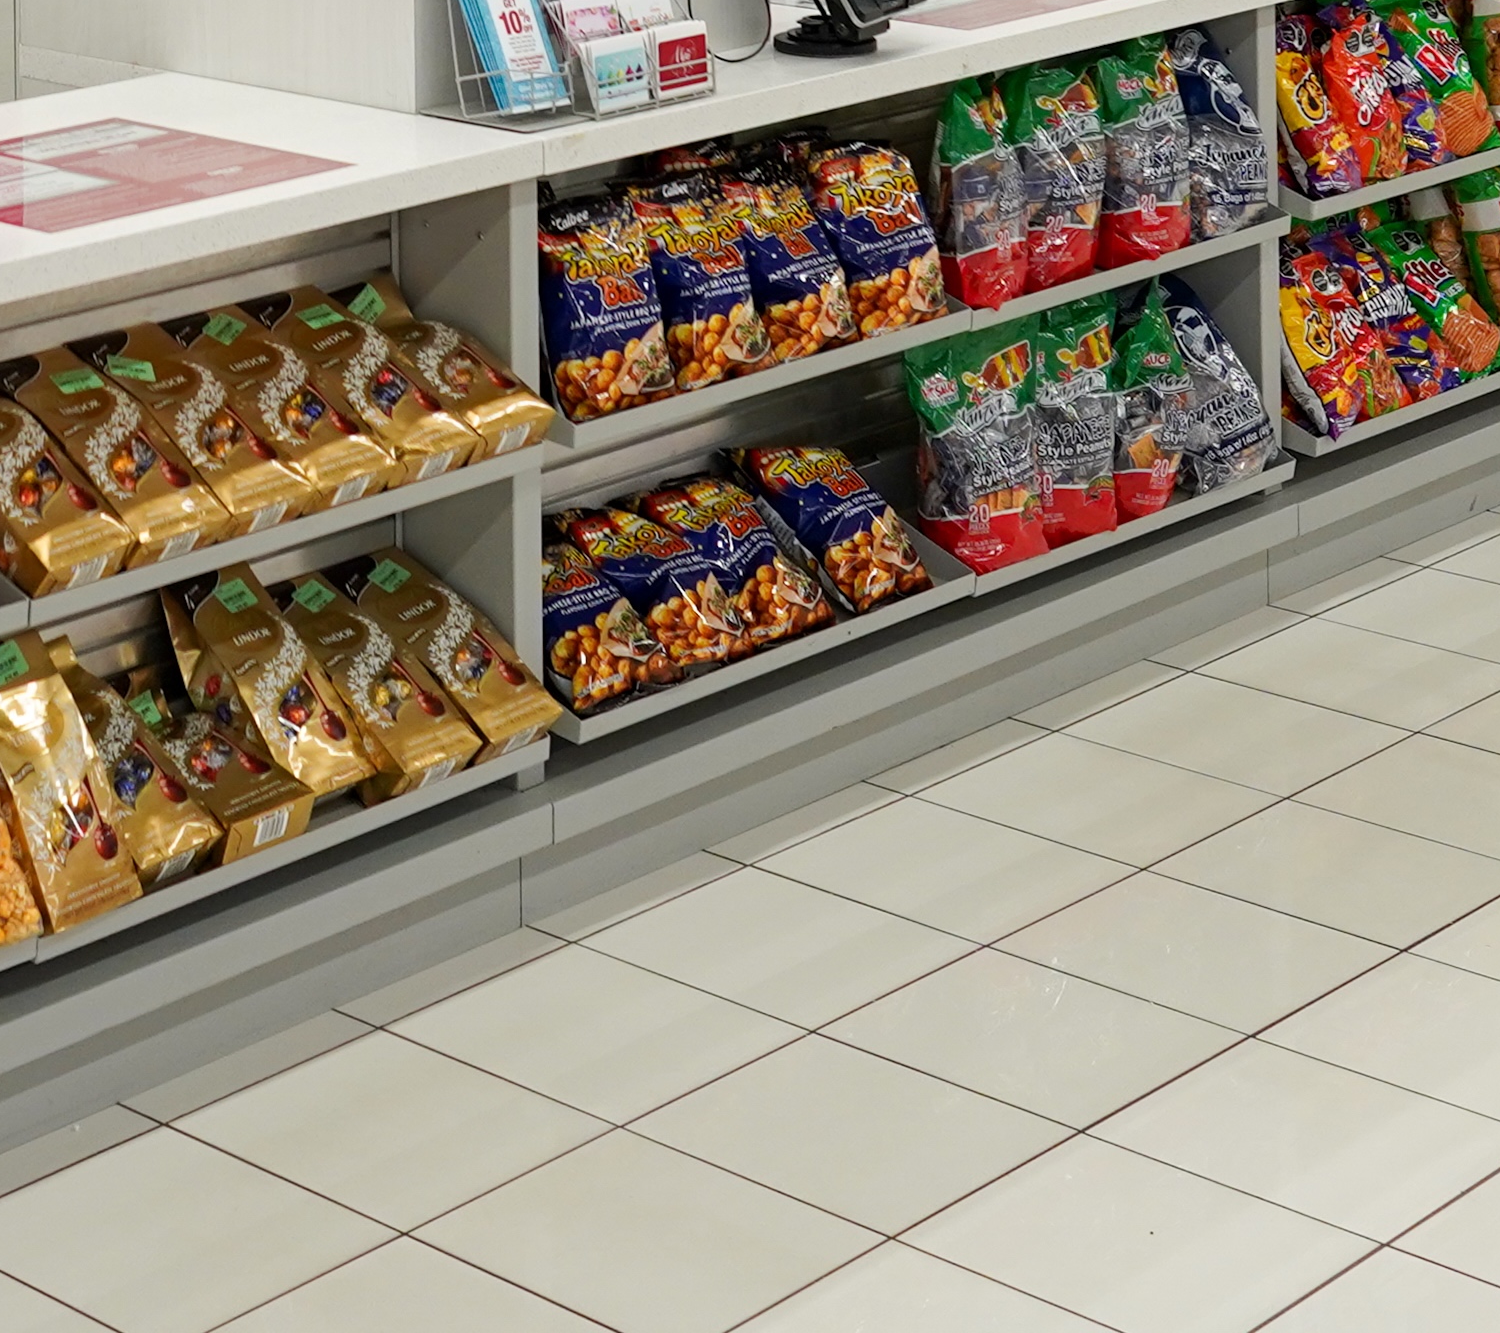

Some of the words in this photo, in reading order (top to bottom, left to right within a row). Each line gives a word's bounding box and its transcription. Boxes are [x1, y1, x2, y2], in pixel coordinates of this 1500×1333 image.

[499, 8, 530, 35] 10%
[1140, 194, 1157, 211] 20
[556, 208, 590, 231] Calbee
[865, 199, 923, 235] Ball
[1045, 216, 1065, 233] 20
[691, 243, 745, 275] Ball
[1037, 444, 1074, 457] Style
[1076, 437, 1113, 455] Peanuts
[1162, 431, 1188, 444] Style
[1151, 459, 1169, 477] 20
[828, 471, 869, 499] Ball
[724, 507, 768, 540] Ball
[968, 504, 991, 522] 20
